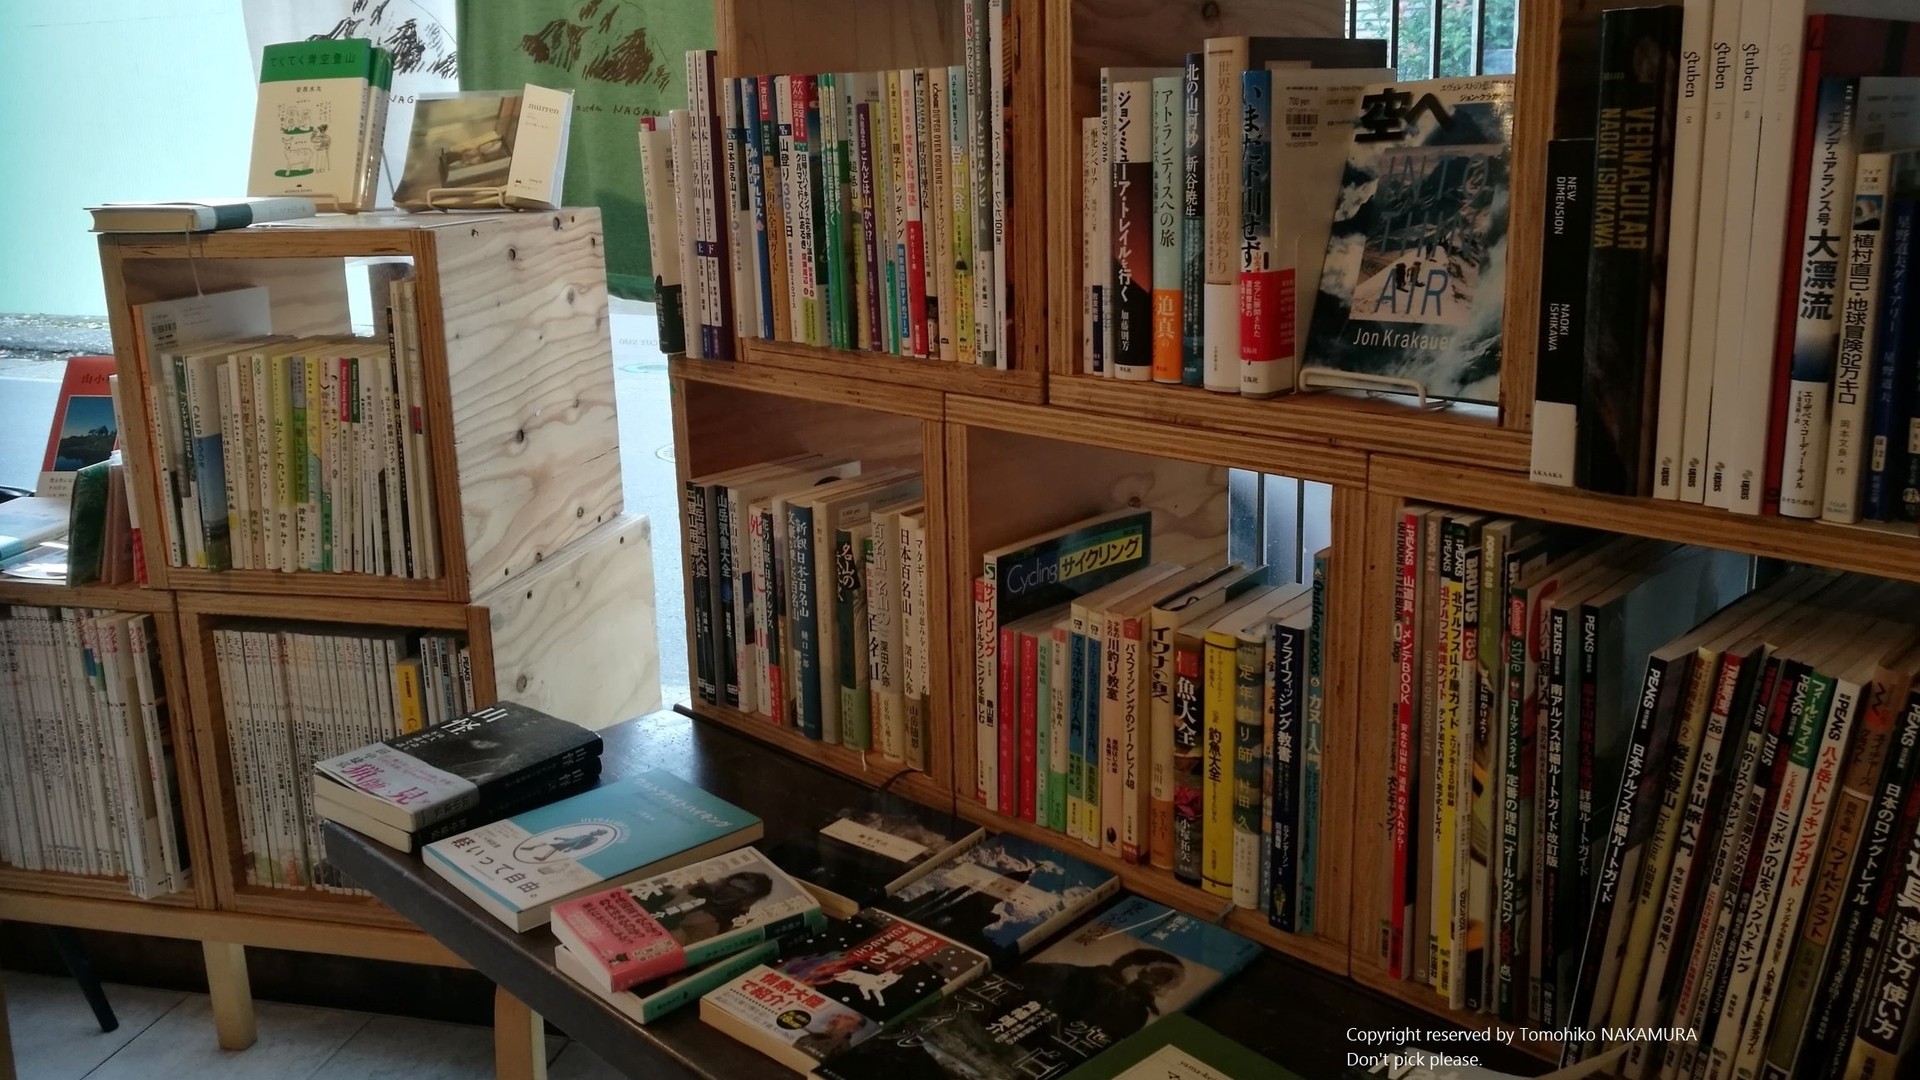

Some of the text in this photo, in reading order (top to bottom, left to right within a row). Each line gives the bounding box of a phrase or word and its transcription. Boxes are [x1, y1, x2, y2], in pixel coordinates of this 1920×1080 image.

[1683, 51, 1701, 99] Stuben
[1713, 42, 1731, 90] Stuben
[1741, 43, 1760, 92] Stuben
[1185, 63, 1200, 149] 北の山河抄
[1354, 88, 1452, 142] 空へ
[727, 142, 738, 192] 日本百名山
[951, 145, 966, 212] 登山食
[975, 111, 988, 207] ソトごはんレシピ
[1160, 89, 1175, 248] アトランティスへの旅
[1216, 60, 1232, 275] 世界の狩猟と自由狩猟の終わり
[1593, 108, 1622, 249] NAOKI ISHIKAWA
[1617, 106, 1657, 252] VERNACULAR
[1817, 112, 1841, 226] エンデュアランス号
[892, 144, 905, 239] 親子トレッキング
[1116, 90, 1133, 303] ジョン・ミューア・トレイルを行く
[1185, 155, 1200, 217] 新谷暁生
[1555, 176, 1568, 235] DIMENSION
[1568, 176, 1577, 202] NEW
[1375, 269, 1449, 316] AIR
[1800, 229, 1842, 321] 大漂流
[1119, 310, 1130, 351] 加藤則芳
[1353, 328, 1456, 350] Jon Krakauer
[1547, 303, 1560, 352] ISHIKAWA
[1559, 303, 1570, 336] NAOKI
[1837, 233, 1876, 405] 植村直己・地球冒険62万キロ
[192, 405, 203, 434] CAMP
[695, 493, 709, 578] 山岳読図大全
[716, 495, 732, 578] 山岳気象大全
[1061, 536, 1141, 578] サイクリング
[1404, 524, 1416, 566] PEAKS
[1443, 537, 1452, 573] PEAKS
[1454, 542, 1465, 578] PEAKS
[794, 520, 810, 619] 新釈日本百名山
[839, 542, 855, 588] 名山の
[900, 528, 913, 616] 日本百名山
[1006, 556, 1059, 596] Cycling
[1464, 555, 1479, 624] BRUTUS
[984, 582, 997, 658] サイクリング
[1464, 627, 1477, 661] 783
[1553, 615, 1564, 656] PEAKS
[1585, 614, 1596, 654] PEAKS
[463, 656, 471, 682] PEAKS
[880, 641, 891, 688] 深田久弥
[904, 645, 914, 694] 深田久弥
[1106, 638, 1120, 701] 川釣り教室
[1448, 591, 1463, 731] 北アルプス山小屋ガイド
[1510, 640, 1523, 672] Style
[1237, 663, 1254, 764] 定年釣り師
[1277, 632, 1293, 763] フライフィッシング教書
[1643, 667, 1661, 711] PEAKS
[1754, 704, 1767, 727] PLUS
[1791, 673, 1811, 716] PEAKS
[440, 707, 509, 736] 山怪
[1124, 643, 1136, 790] バスフィッシングのシークレット48
[1708, 722, 1722, 735] 26
[1828, 694, 1851, 741] PEAKS
[1900, 703, 1920, 748] PEAKS
[1208, 727, 1221, 783] 釣魚大全
[1546, 683, 1564, 869] 南アルプス詳細ルートガイド改訂版
[1761, 733, 1779, 767] PLUS
[1238, 778, 1249, 831] 村田久
[1504, 774, 1519, 837] 定番の理由
[1600, 743, 1646, 903] 日本アルプス詳細ルートガイド
[1789, 746, 1837, 888] 八ヶ岳トレッキングガイド
[450, 835, 541, 898] 軽いって自由。
[1179, 820, 1191, 863] 小塚拓矢
[1853, 783, 1903, 907] 日本のロングトレイル
[1736, 811, 1790, 974] ニッポンの山をバックパッキング
[854, 926, 909, 957] KUMAUCHI
